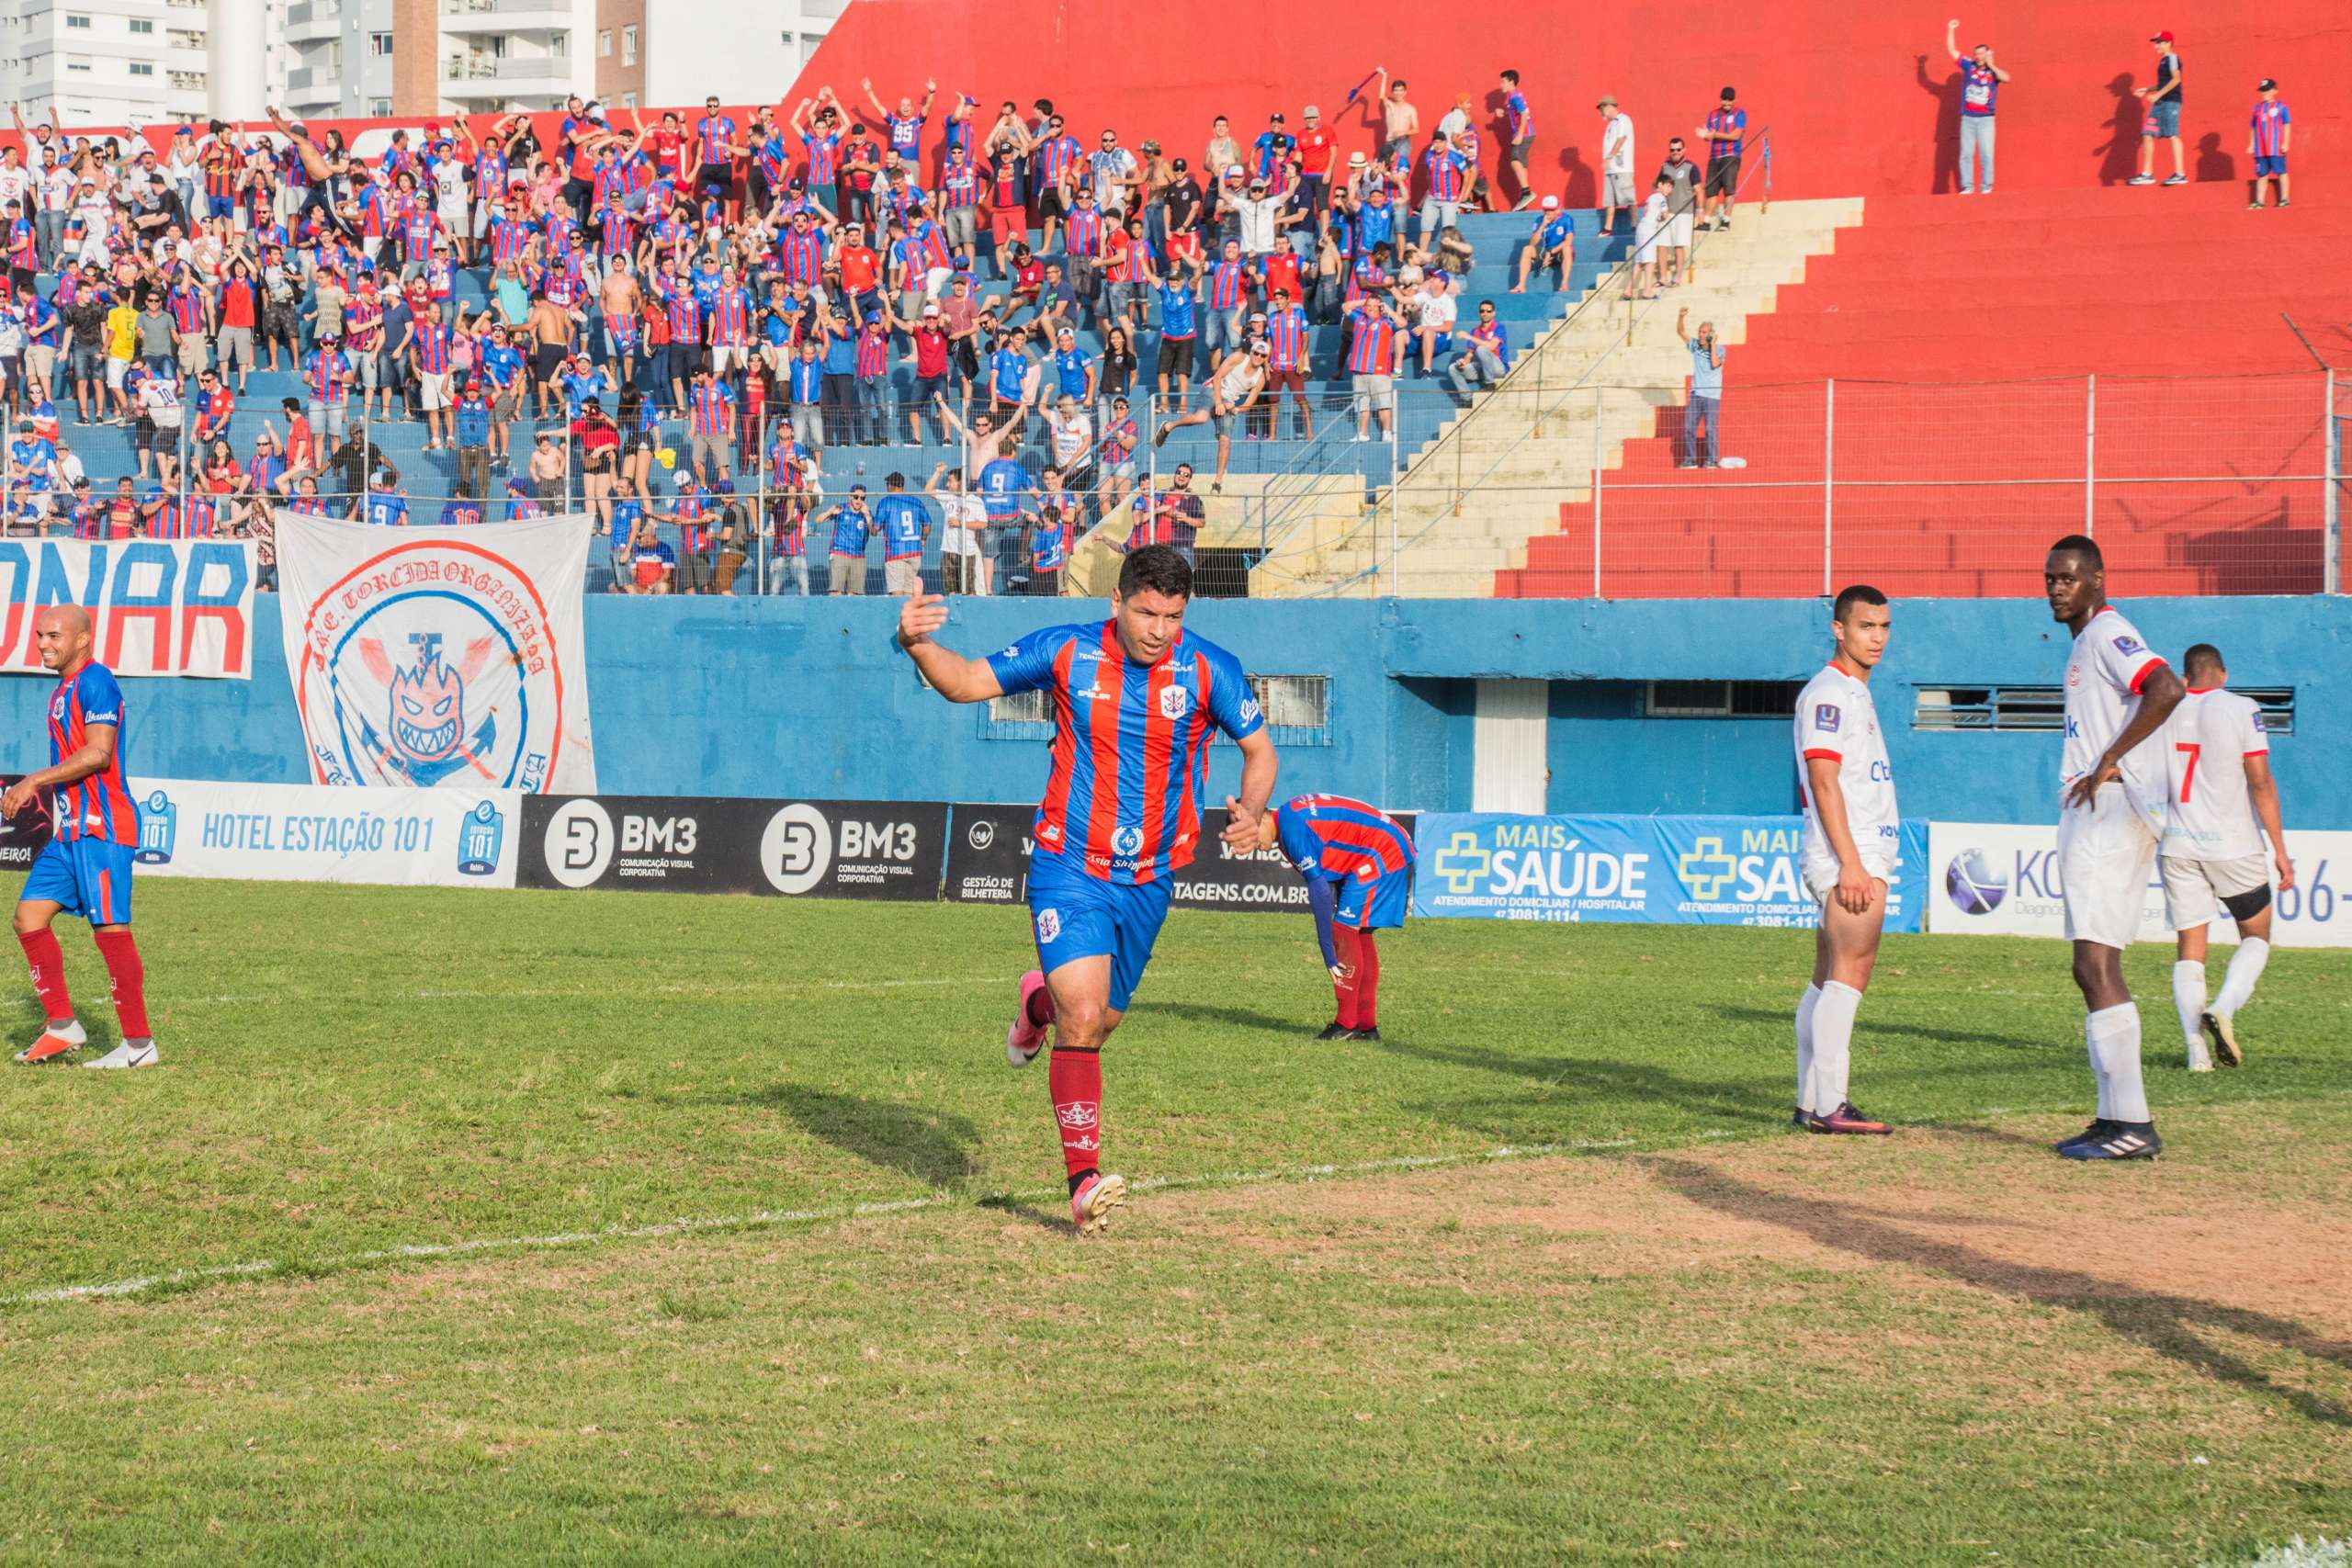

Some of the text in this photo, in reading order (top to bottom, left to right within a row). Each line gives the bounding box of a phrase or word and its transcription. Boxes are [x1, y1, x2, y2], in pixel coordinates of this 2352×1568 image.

[157, 388, 174, 406] 10
[991, 473, 1005, 497] 9
[375, 504, 386, 525] 9
[453, 508, 479, 525] 10
[901, 510, 914, 536] 9
[342, 559, 440, 610] TORCIDA
[2176, 742, 2200, 804] 7
[143, 824, 167, 848] 101
[201, 812, 434, 859] HOTEL ESTAÇÃO 101
[621, 816, 697, 854] BM3
[839, 820, 917, 860] BM3
[1495, 824, 1566, 849] MAIS
[1741, 829, 1798, 853] MAI
[468, 834, 493, 859] 101
[620, 858, 694, 869] COMUNICAÇÃO VISUAL
[838, 863, 913, 875] COMUNICAÇÃO VISUAL
[1087, 854, 1111, 867] Asia
[1489, 840, 1649, 898] SAÚDE
[620, 868, 665, 877] CORPORATIVA
[837, 874, 885, 884] CORPORATIVA
[963, 875, 1013, 887] GESTÃO DE
[962, 887, 1012, 898] BILHETERIA
[1171, 882, 1310, 905] TAGENS.COM.BR
[1433, 896, 1507, 907] ATENDIMENTO
[1509, 897, 1570, 908] DOMICILIAR
[1577, 899, 1645, 910] HOSPITALAR
[1508, 908, 1580, 921] 3081-1114
[1678, 903, 1755, 914] ATENDIMENTO
